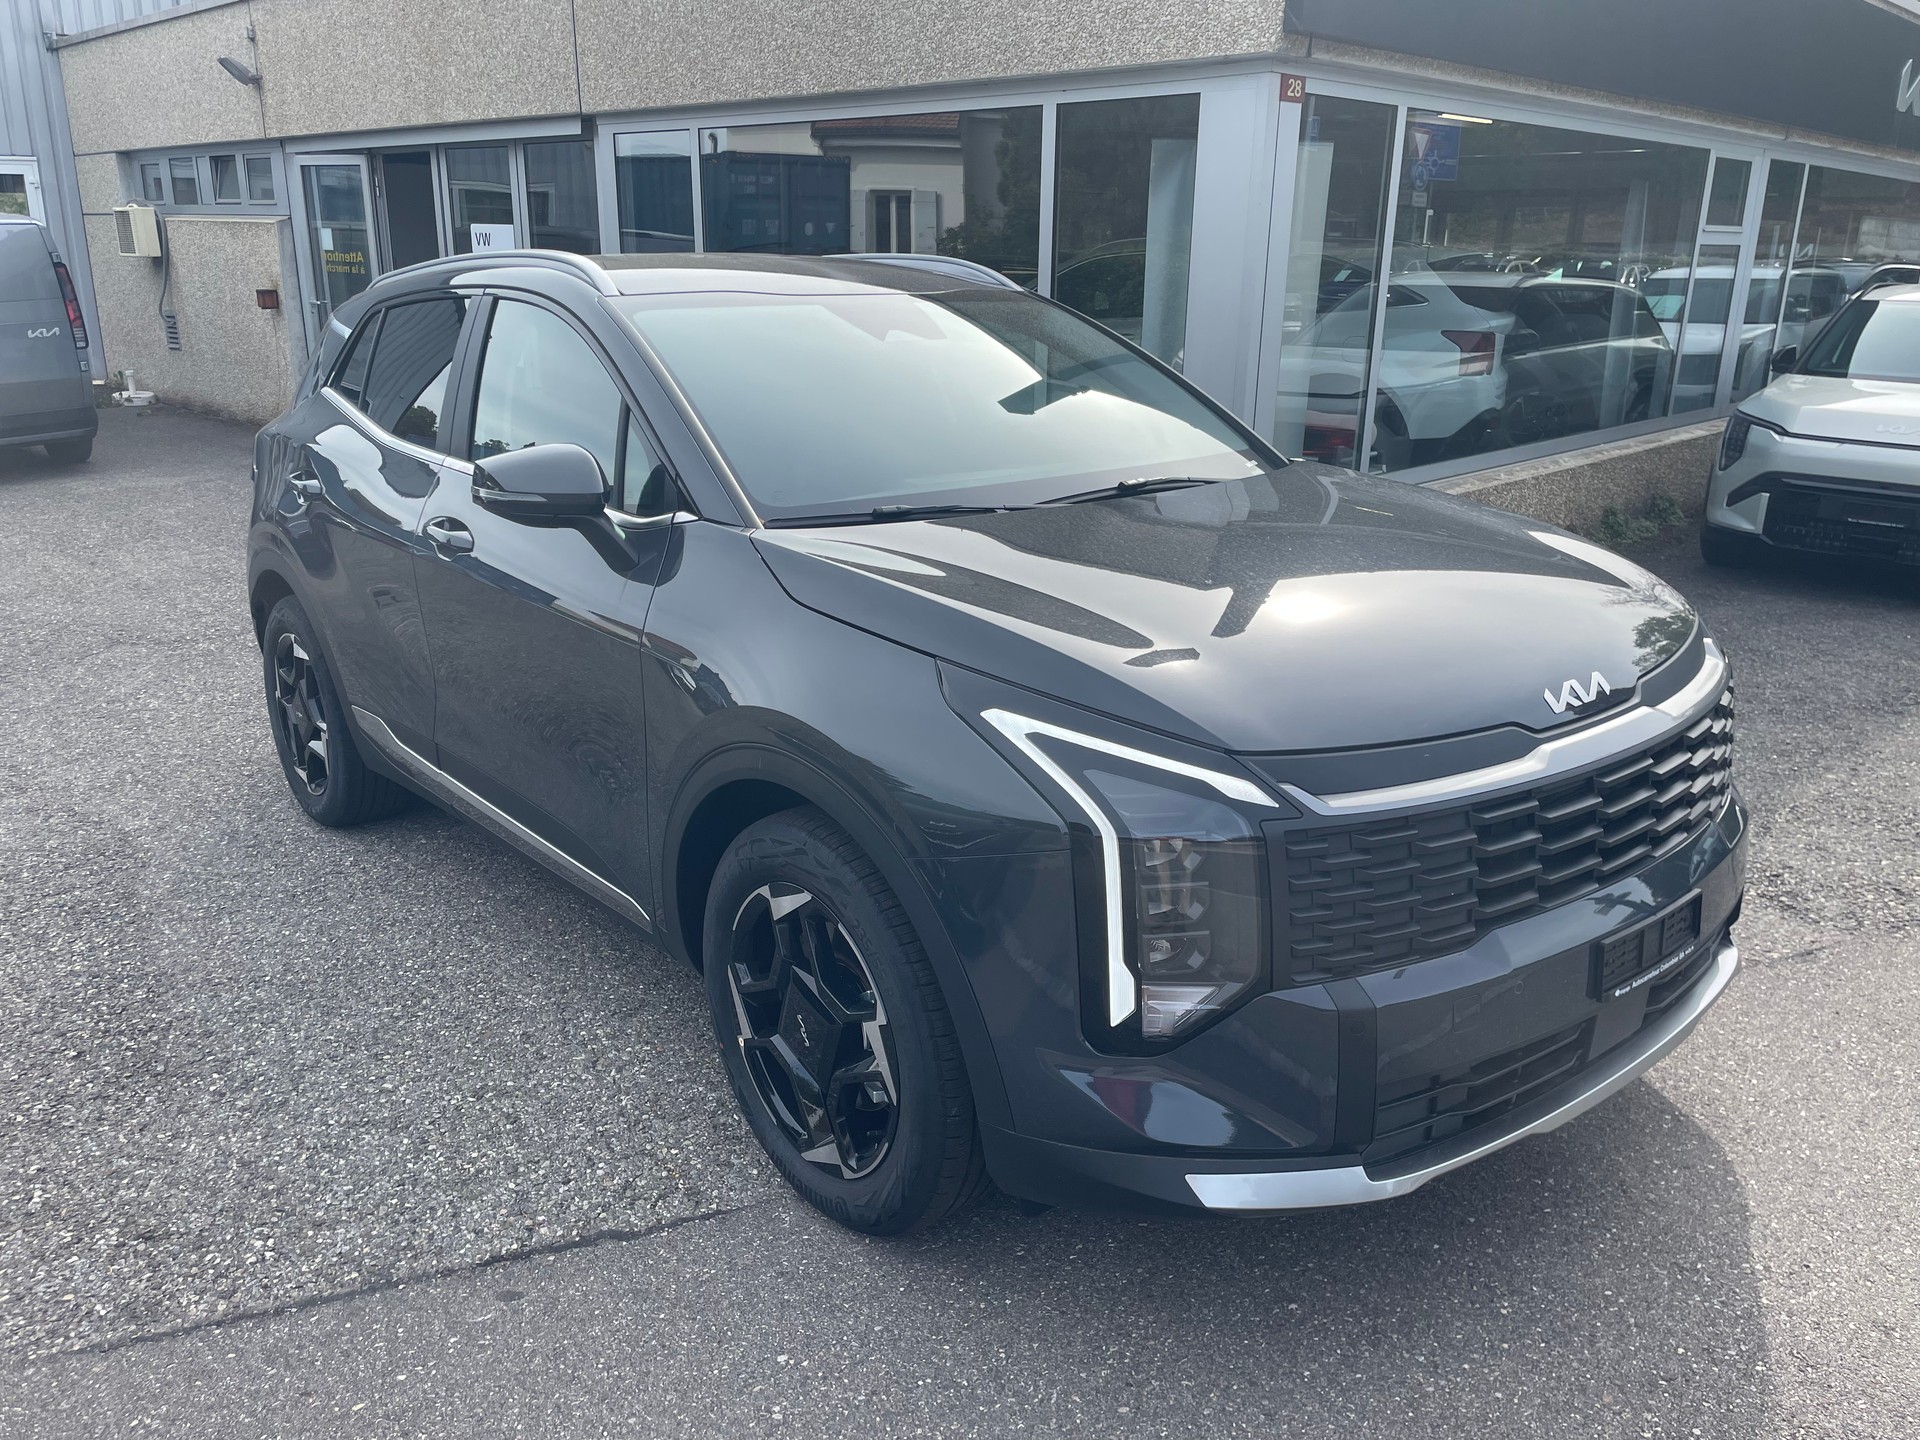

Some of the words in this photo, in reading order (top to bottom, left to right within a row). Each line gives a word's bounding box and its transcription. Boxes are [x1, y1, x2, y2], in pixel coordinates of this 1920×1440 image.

[1287, 78, 1302, 97] 28
[475, 232, 491, 247] VW
[27, 327, 60, 339] KIA
[1543, 671, 1611, 714] KIA
